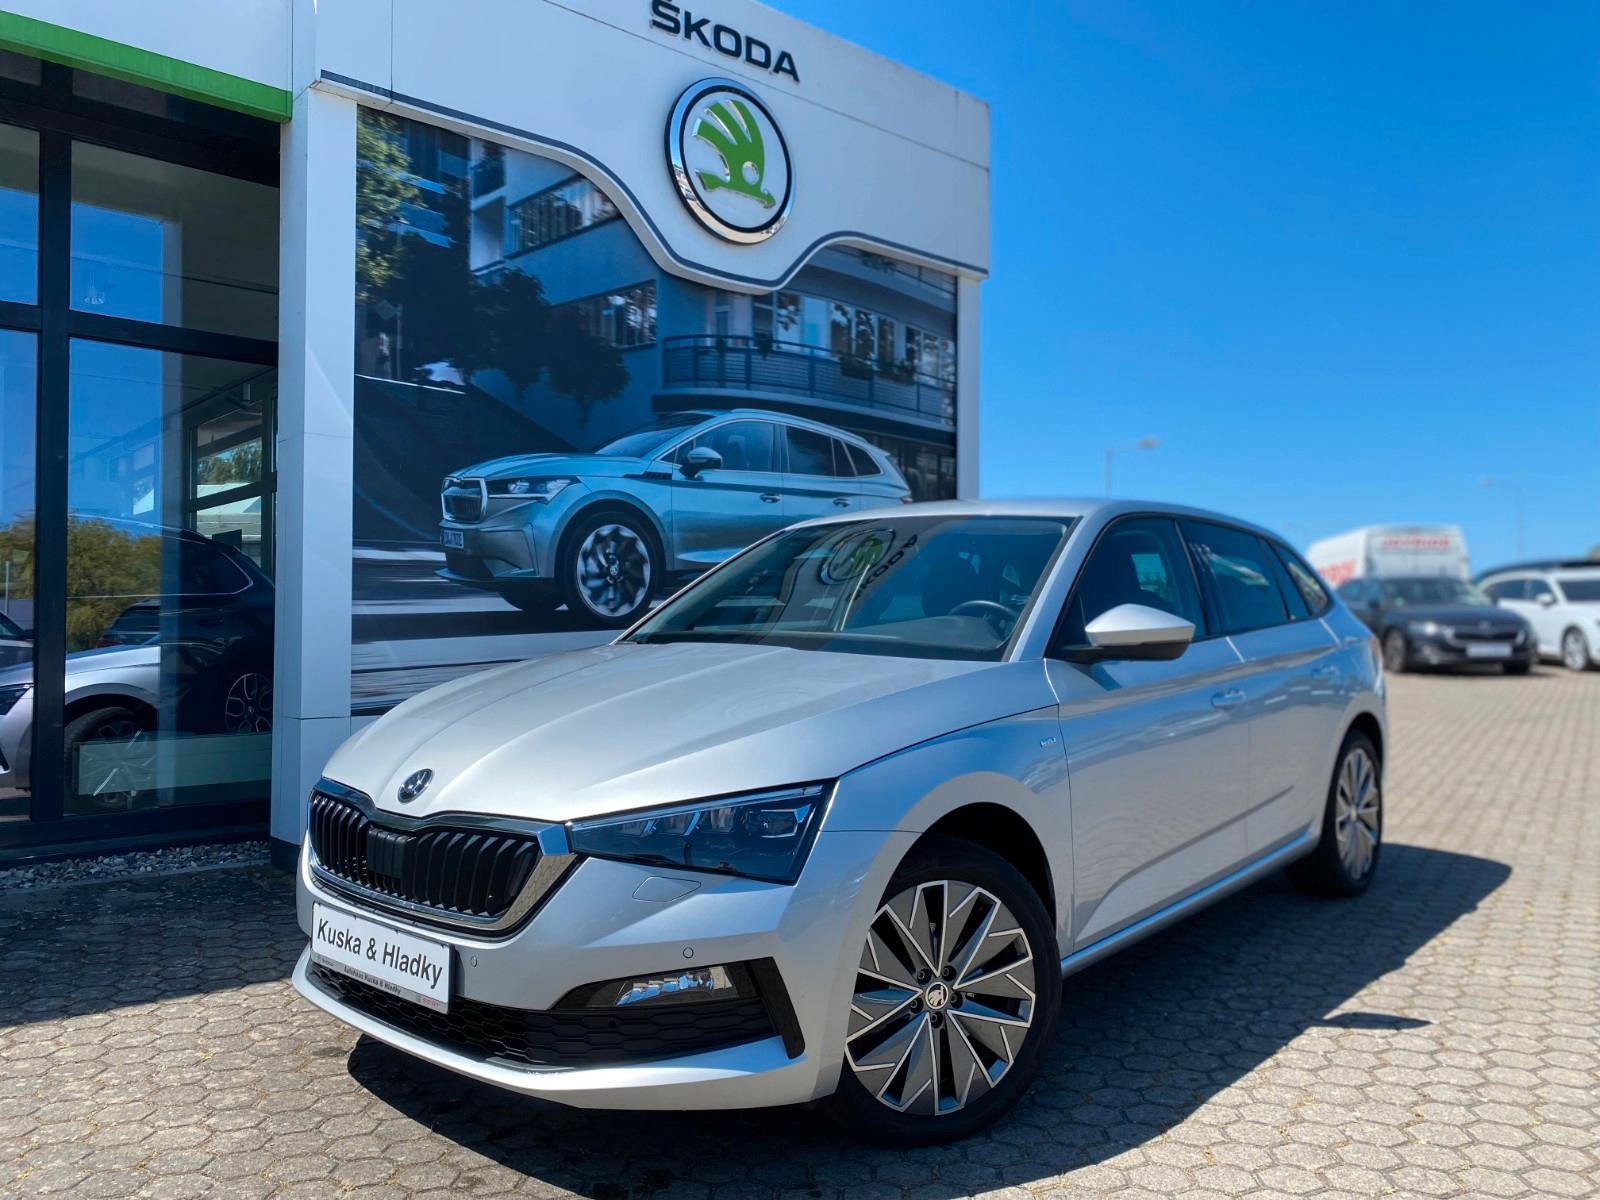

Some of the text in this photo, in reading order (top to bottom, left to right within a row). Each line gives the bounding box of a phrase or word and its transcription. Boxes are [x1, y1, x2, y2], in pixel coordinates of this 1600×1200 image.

[651, 0, 800, 83] ŠKODA
[317, 918, 443, 990] Kuska & Hladky
